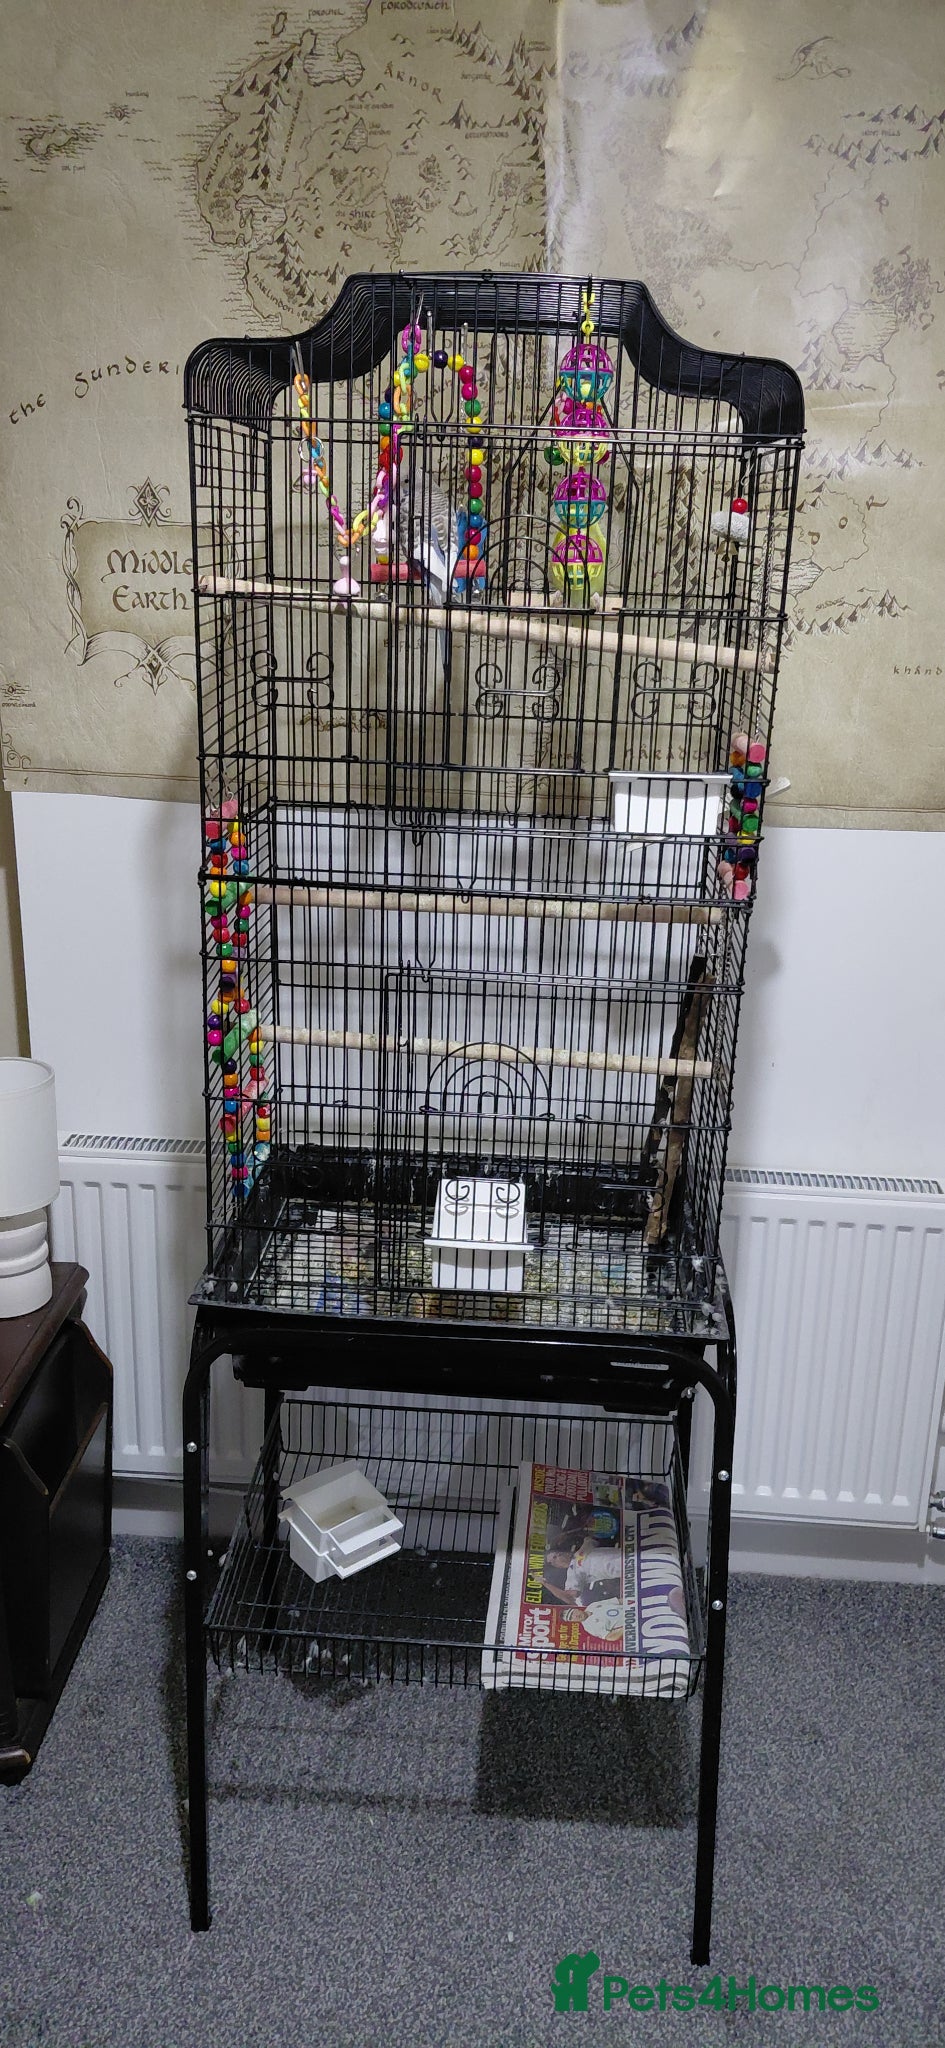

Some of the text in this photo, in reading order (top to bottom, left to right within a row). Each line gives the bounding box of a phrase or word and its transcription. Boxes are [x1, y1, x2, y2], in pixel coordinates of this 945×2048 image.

[8, 394, 47, 425] the
[100, 549, 194, 583] Middle
[112, 585, 193, 613] Earth
[543, 1477, 556, 1495] YOUR
[556, 1473, 567, 1496] RACING
[566, 1470, 578, 1499] FOOTBALL
[624, 1524, 635, 1542] CITY
[529, 1553, 545, 1570] WIN
[639, 1512, 684, 1589] WANT
[624, 1543, 636, 1598] MANCHESTER
[518, 1614, 534, 1646] Mirror
[526, 1608, 556, 1660] Sport
